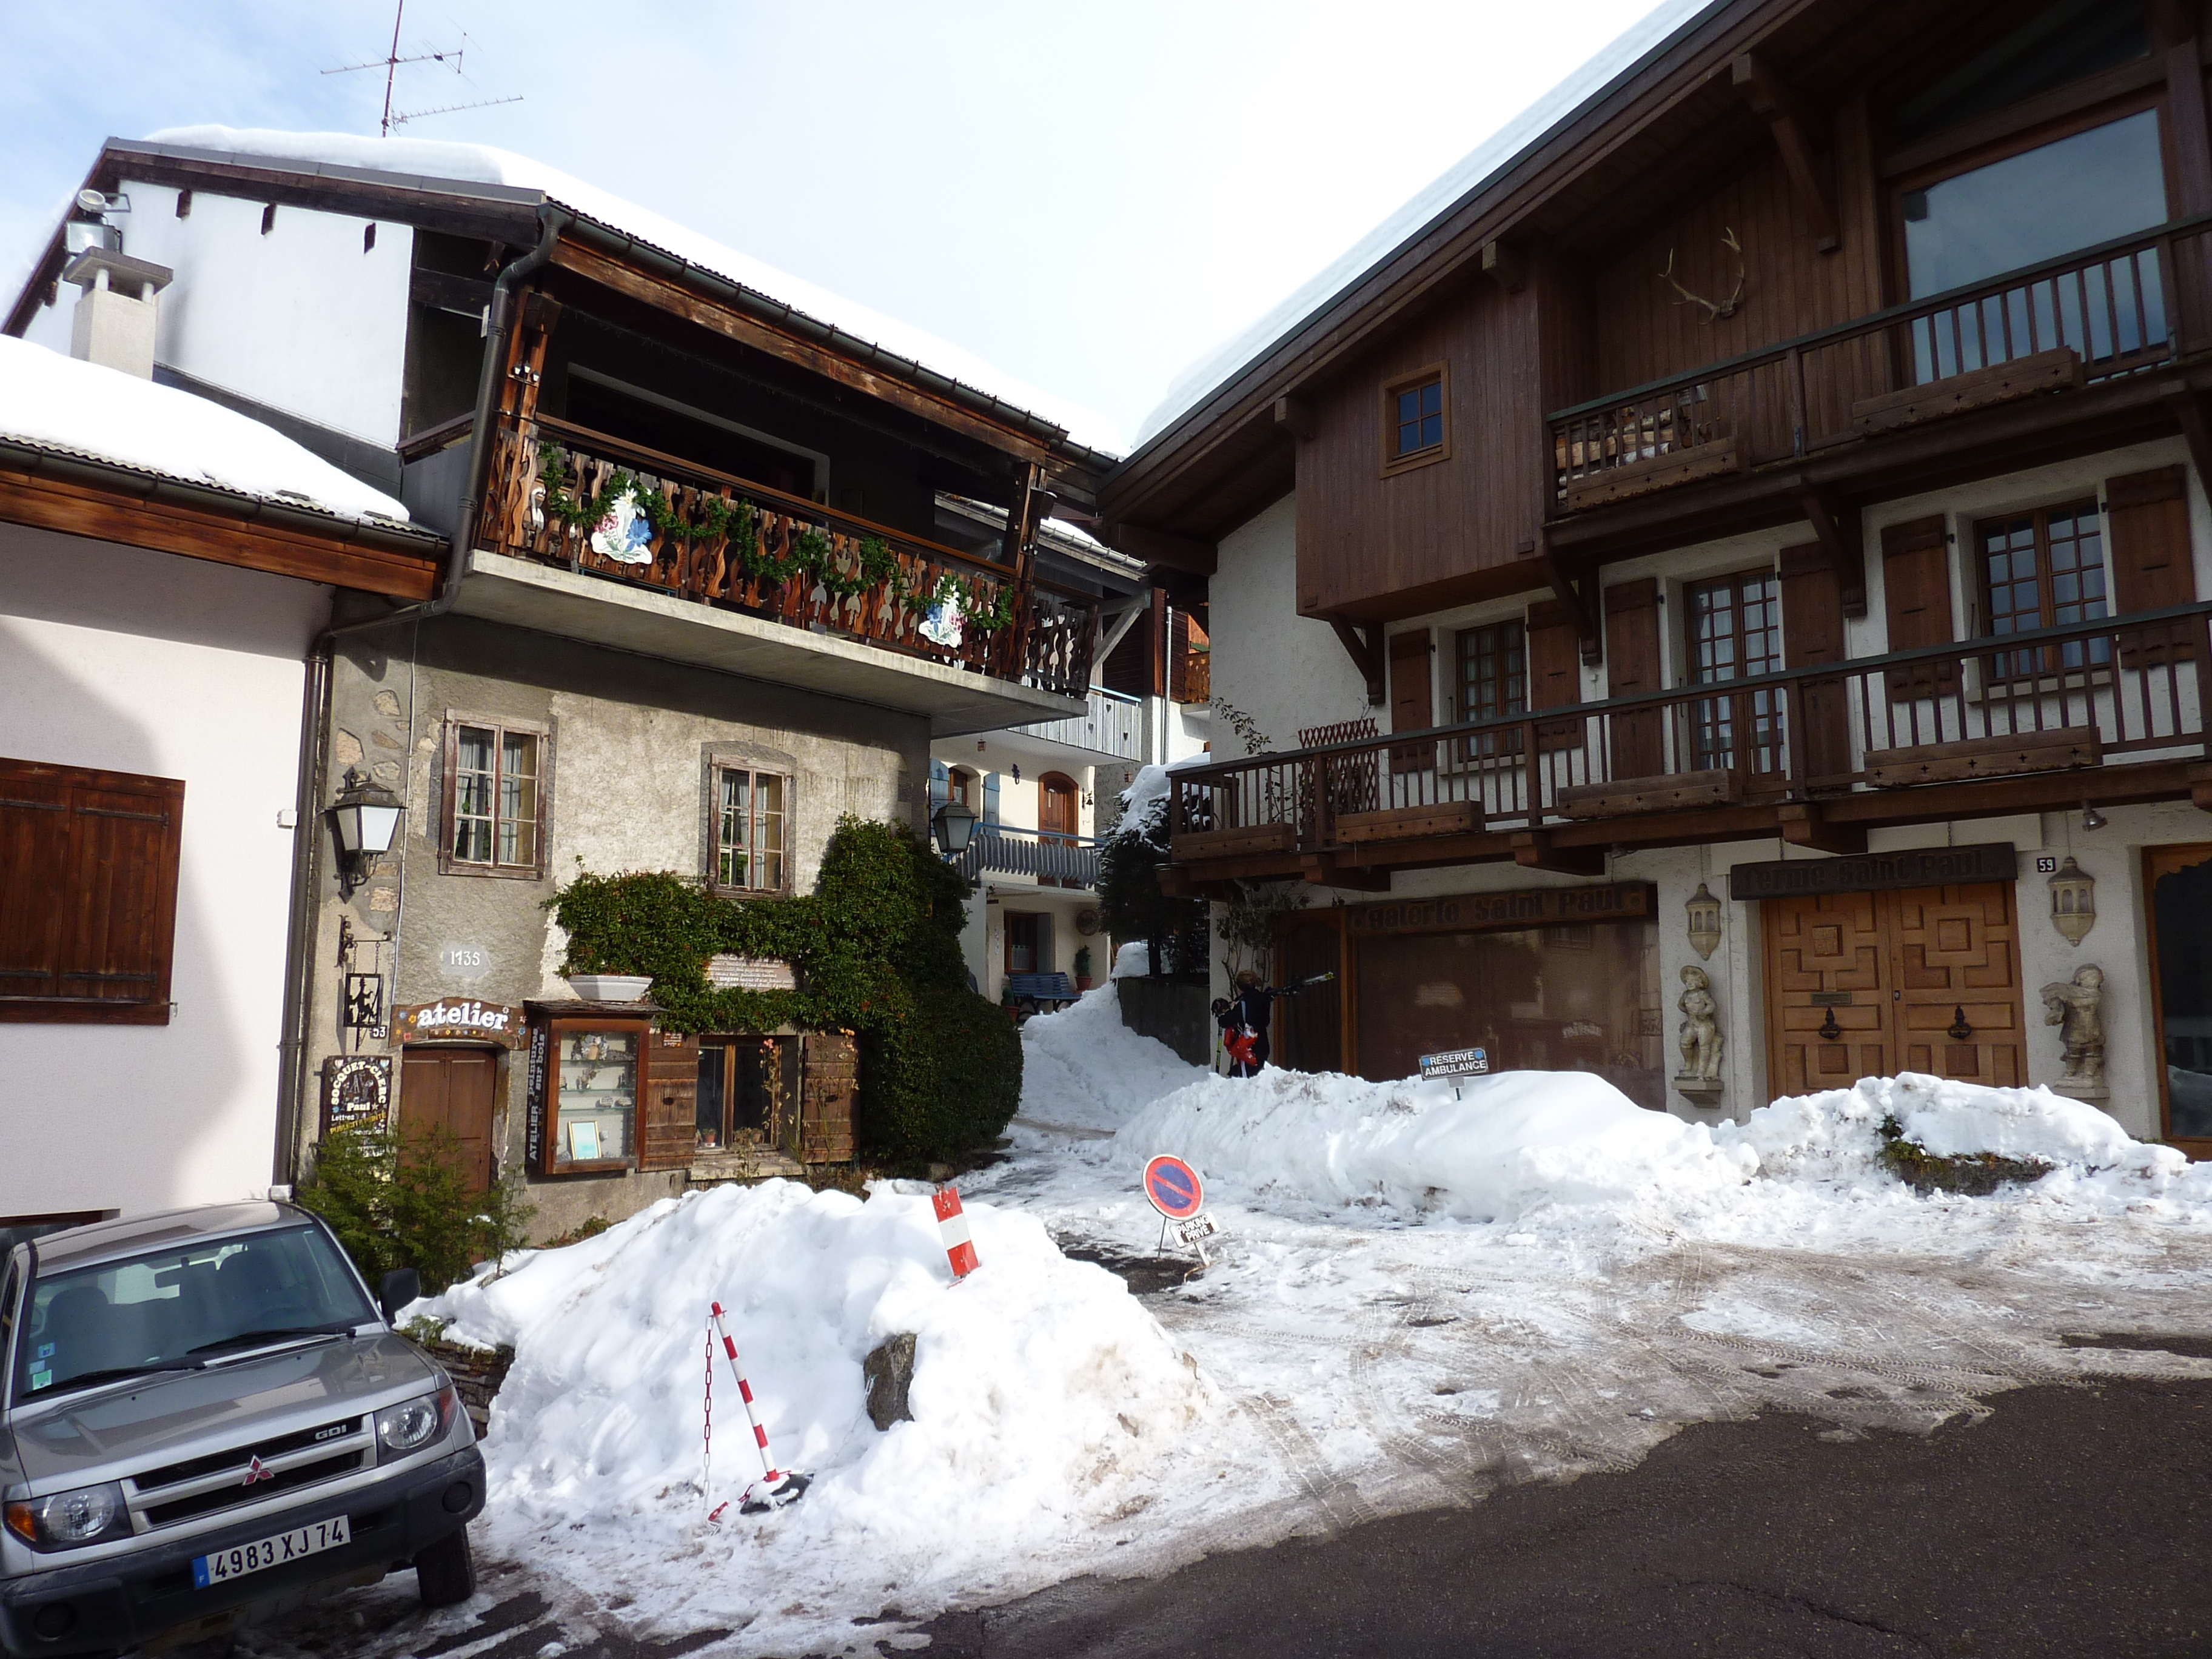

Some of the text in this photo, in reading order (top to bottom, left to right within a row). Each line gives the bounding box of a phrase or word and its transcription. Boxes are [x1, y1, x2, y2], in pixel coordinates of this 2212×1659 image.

[2039, 859, 2054, 871] 59
[417, 1001, 509, 1030] atelier
[535, 1033, 545, 1091] sur bois
[1425, 1060, 1486, 1076] AMBULANCE
[331, 1061, 387, 1105] SOCQUET-CLERC
[347, 1102, 370, 1111] Paul
[529, 1105, 539, 1161] ATELIER
[1176, 1215, 1210, 1236] PARKING
[315, 1424, 347, 1440] GDI
[215, 1520, 343, 1578] 4983 XJ 74
